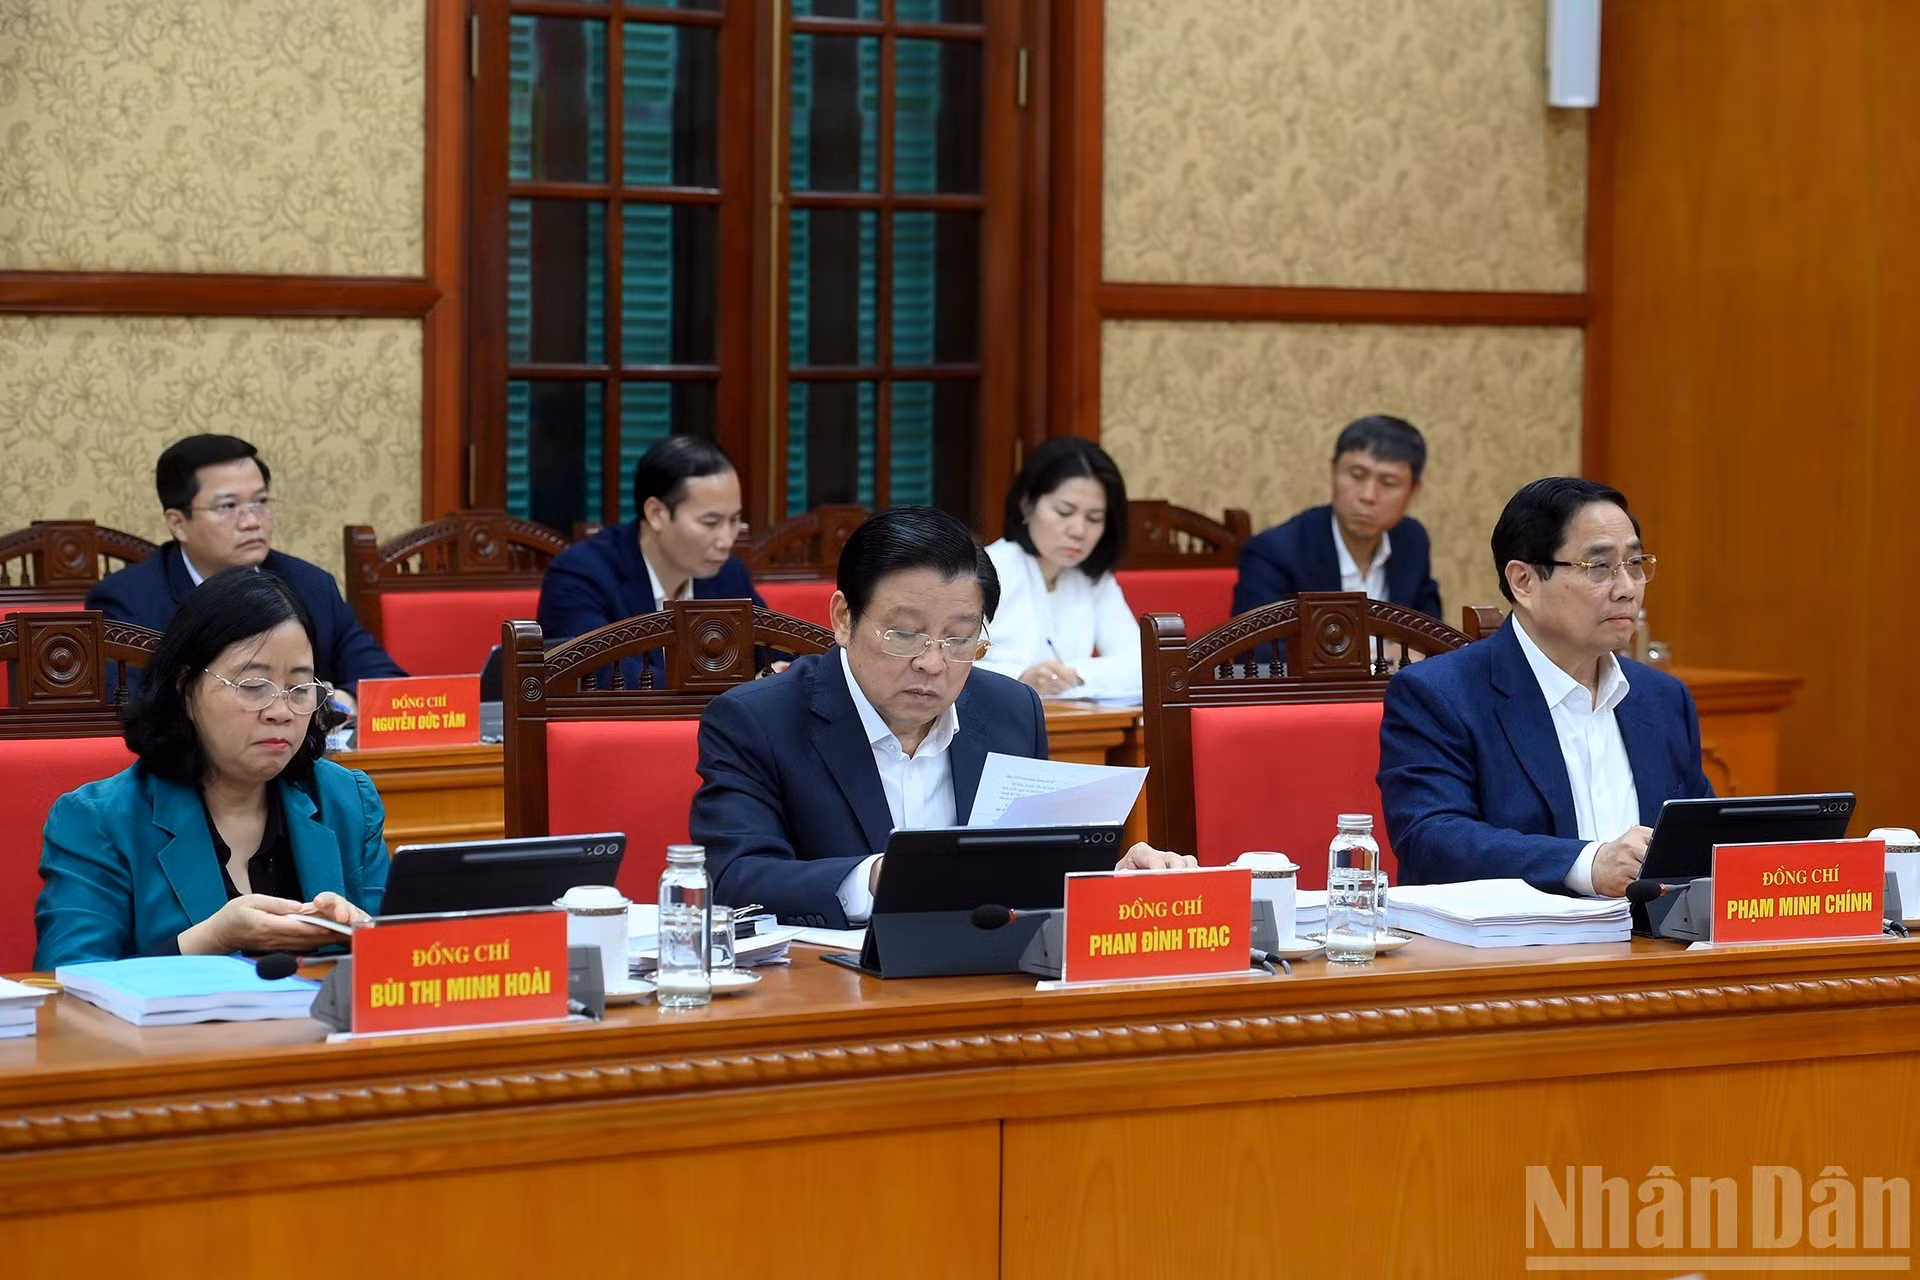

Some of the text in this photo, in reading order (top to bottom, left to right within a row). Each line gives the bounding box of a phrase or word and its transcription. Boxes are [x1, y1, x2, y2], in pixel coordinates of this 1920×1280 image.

[426, 694, 446, 708] CHÍ
[442, 711, 466, 728] TÂM
[1763, 864, 1840, 885] ĐỒNG CHÍ
[1119, 895, 1202, 920] ĐỒNG CHÍ
[1728, 889, 1872, 922] PHẠM MINH CHÍNH
[412, 939, 510, 967] ĐỒNG CHÍ
[1090, 925, 1230, 956] PHAN ĐÌNH TRẠC
[371, 966, 551, 1008] BÙI THỊ MINH HOÀI
